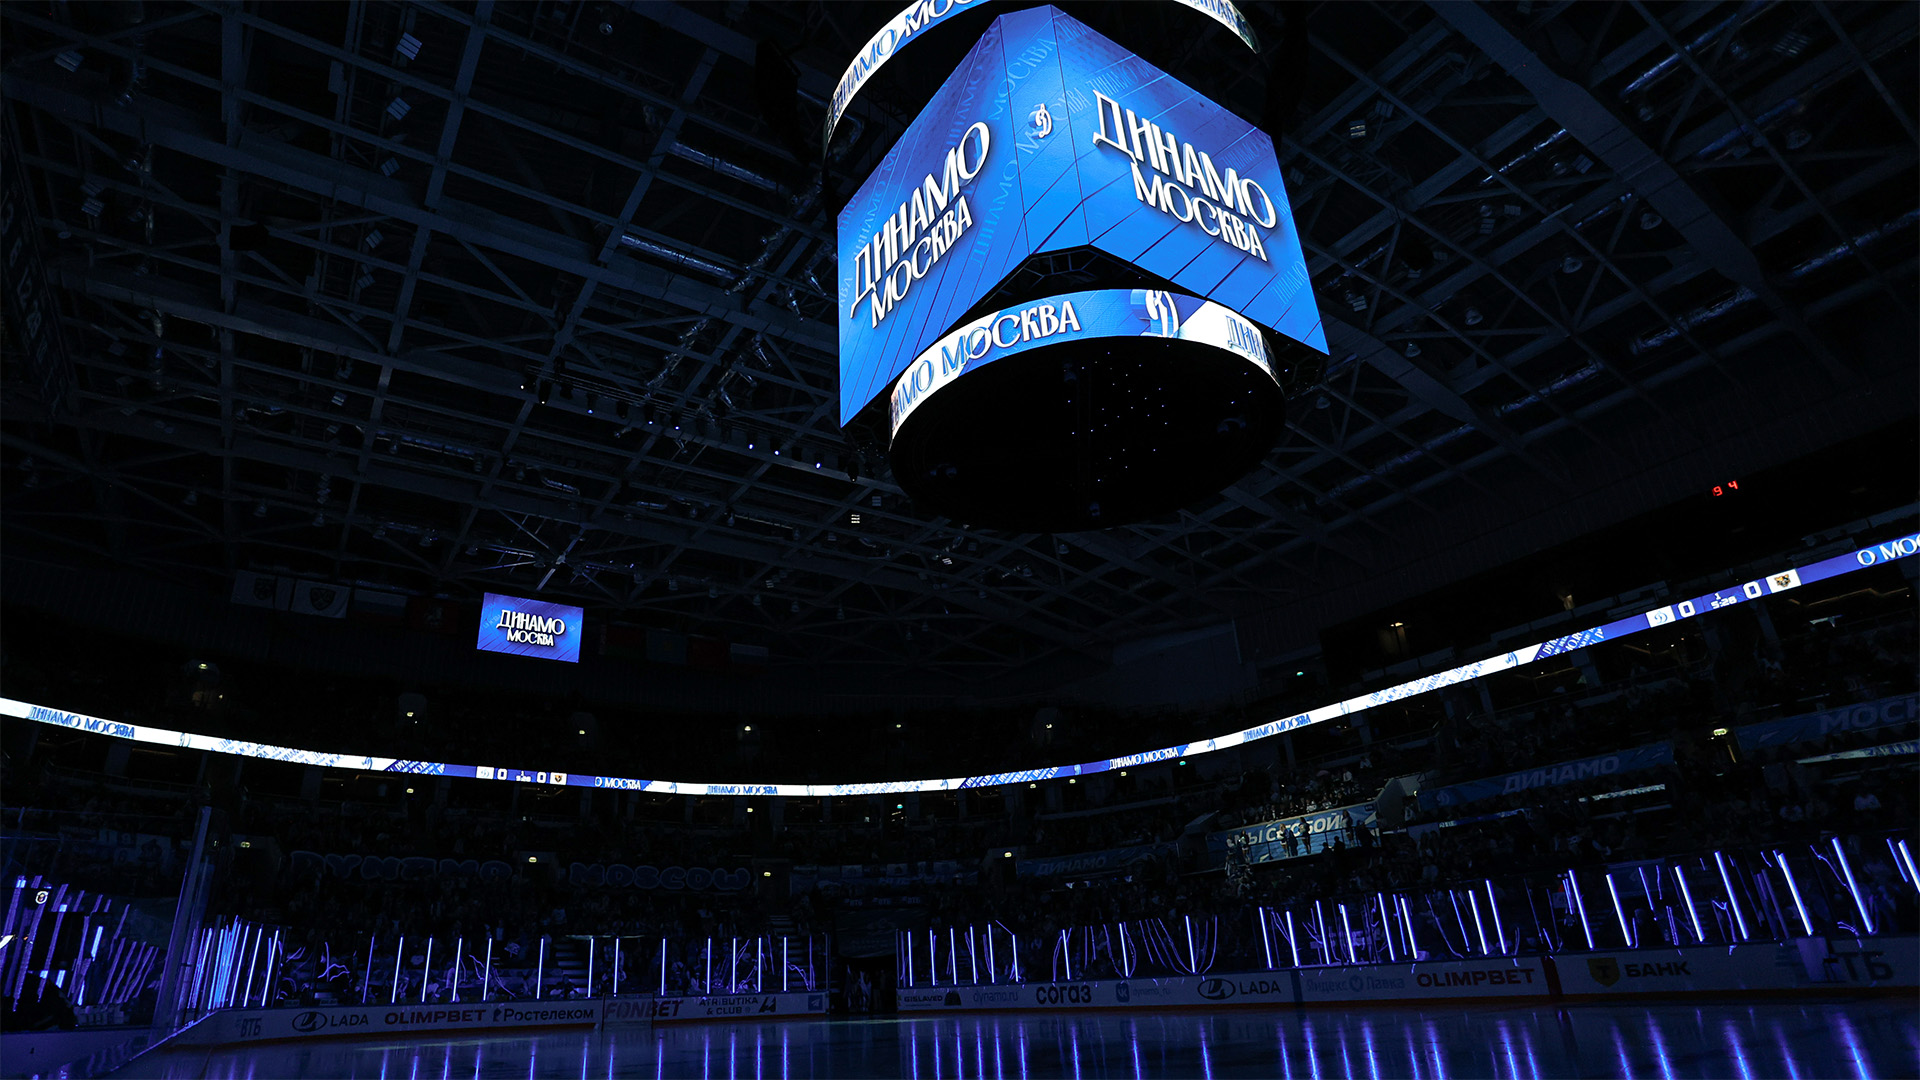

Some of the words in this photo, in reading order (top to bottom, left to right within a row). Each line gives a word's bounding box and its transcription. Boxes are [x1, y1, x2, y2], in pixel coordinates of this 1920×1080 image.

[905, 0, 975, 37] МО
[1092, 89, 1277, 229] ДИНАМО
[850, 121, 990, 318] ДИНАМО
[1131, 162, 1268, 262] МОСКВА
[870, 195, 974, 329] МОСКВА
[890, 359, 935, 428] АМО
[942, 300, 1082, 377] МОСКВА
[1711, 485, 1723, 497] 9
[1728, 480, 1739, 490] 4
[1879, 535, 1920, 561] МО
[1678, 600, 1696, 618] 0
[1743, 581, 1762, 600] 0
[496, 609, 566, 635] ДИНАМО
[506, 628, 554, 647] МОСКВА
[27, 706, 81, 728] ДИНАМО
[84, 717, 135, 739] МОСКВА
[1275, 713, 1312, 732] МОСКВА
[1109, 753, 1141, 770] ДИНАМО
[1143, 747, 1179, 763] МОСКВА
[604, 777, 641, 790] МОСКВА
[1502, 756, 1620, 795] ДИНАМО
[569, 862, 751, 890] MOSCOW
[1623, 961, 1691, 977] БАНК
[1826, 950, 1894, 981] ТБ
[1240, 980, 1281, 996] LADA
[1416, 968, 1534, 988] OLIMPBET
[330, 1014, 369, 1027] LADA
[384, 1009, 486, 1025] OLIMPBET
[503, 1008, 594, 1022] Ростелеком
[603, 999, 684, 1019] FONBET
[716, 1007, 742, 1015] CLUB
